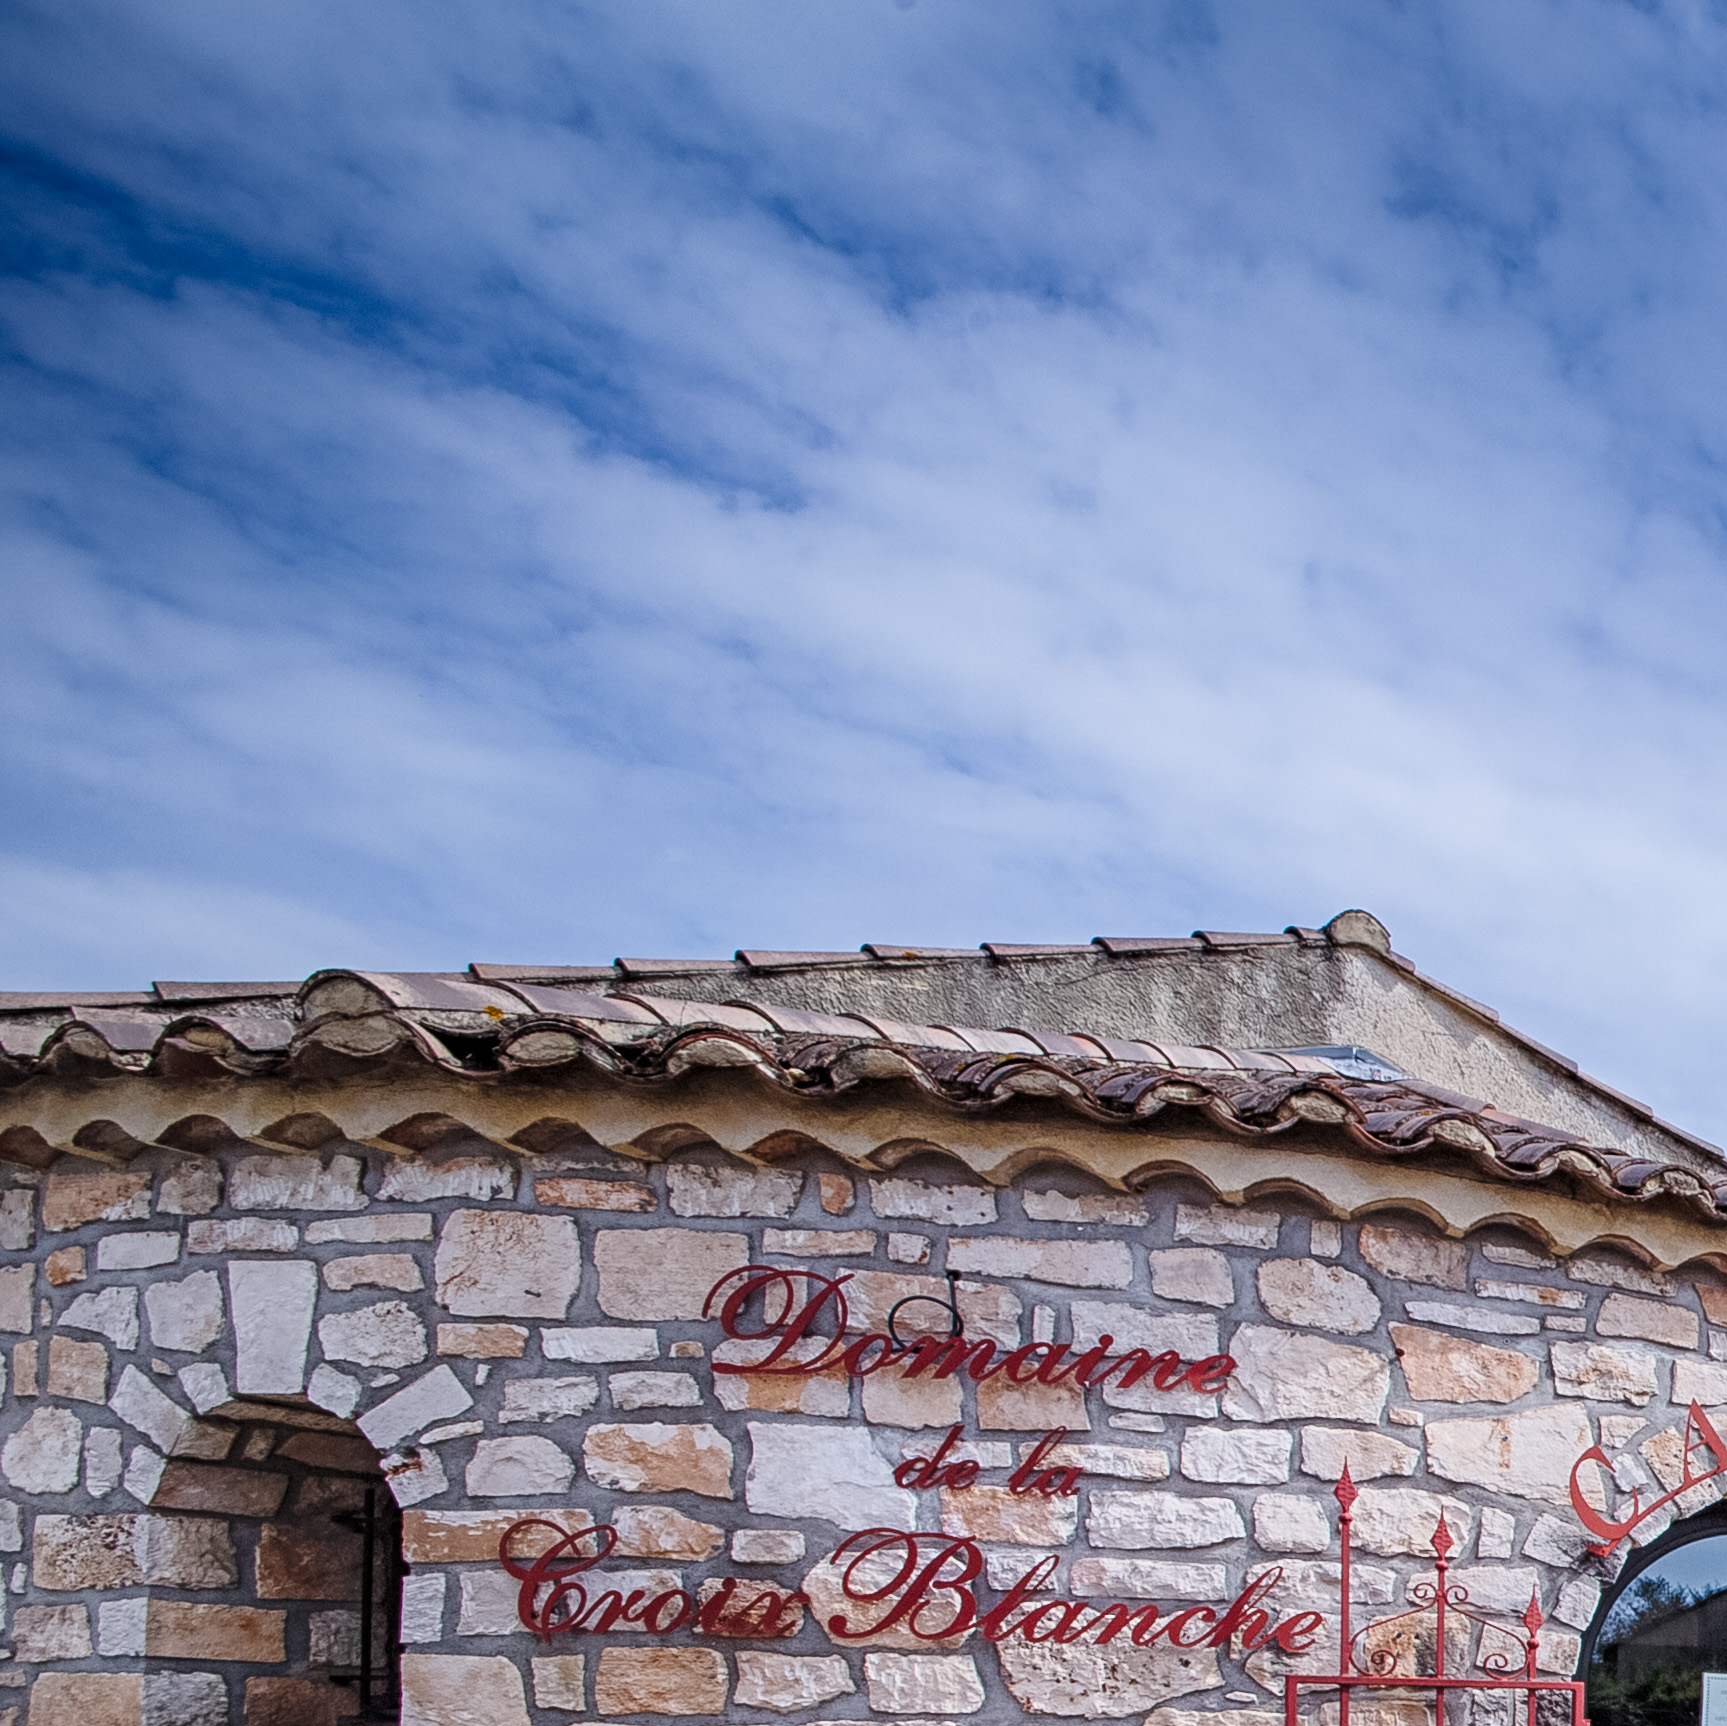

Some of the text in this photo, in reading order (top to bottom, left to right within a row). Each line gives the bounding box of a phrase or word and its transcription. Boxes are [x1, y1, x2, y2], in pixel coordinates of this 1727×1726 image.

[702, 1265, 1236, 1396] Domaine
[892, 1426, 1083, 1498] de la
[499, 1519, 1325, 1653] Croix Blanche
